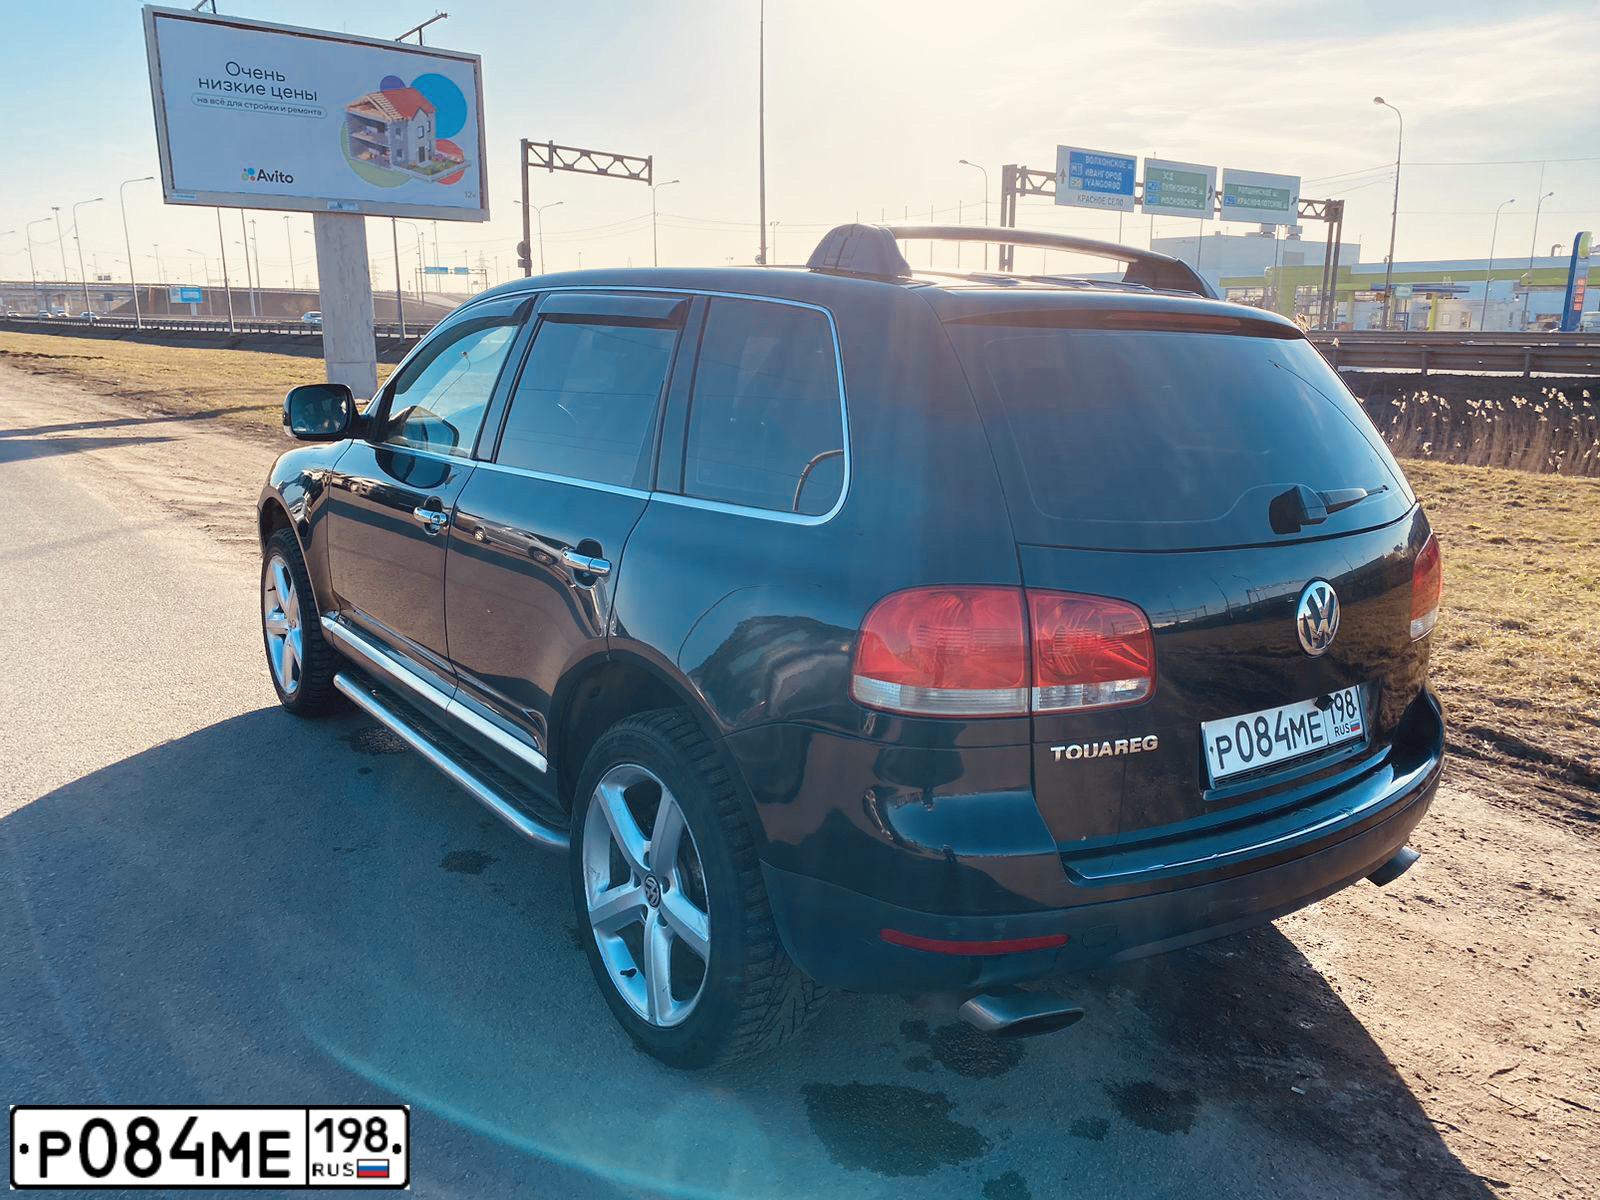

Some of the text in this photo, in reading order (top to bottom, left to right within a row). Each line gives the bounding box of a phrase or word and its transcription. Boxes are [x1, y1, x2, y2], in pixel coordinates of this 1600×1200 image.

[225, 61, 286, 82] Очень
[198, 78, 318, 101] низкие цены
[197, 96, 208, 104] на
[226, 99, 243, 108] для
[243, 101, 280, 112] стройки
[287, 105, 323, 117] ремонта
[256, 169, 294, 184] Avito
[1085, 168, 1122, 181] ИВАНГОРОД
[1077, 194, 1124, 207] КРАСНОЕ СЕЛО
[1329, 690, 1356, 725] 198
[1334, 723, 1350, 737] RUS
[1050, 734, 1159, 762] TOUAREG
